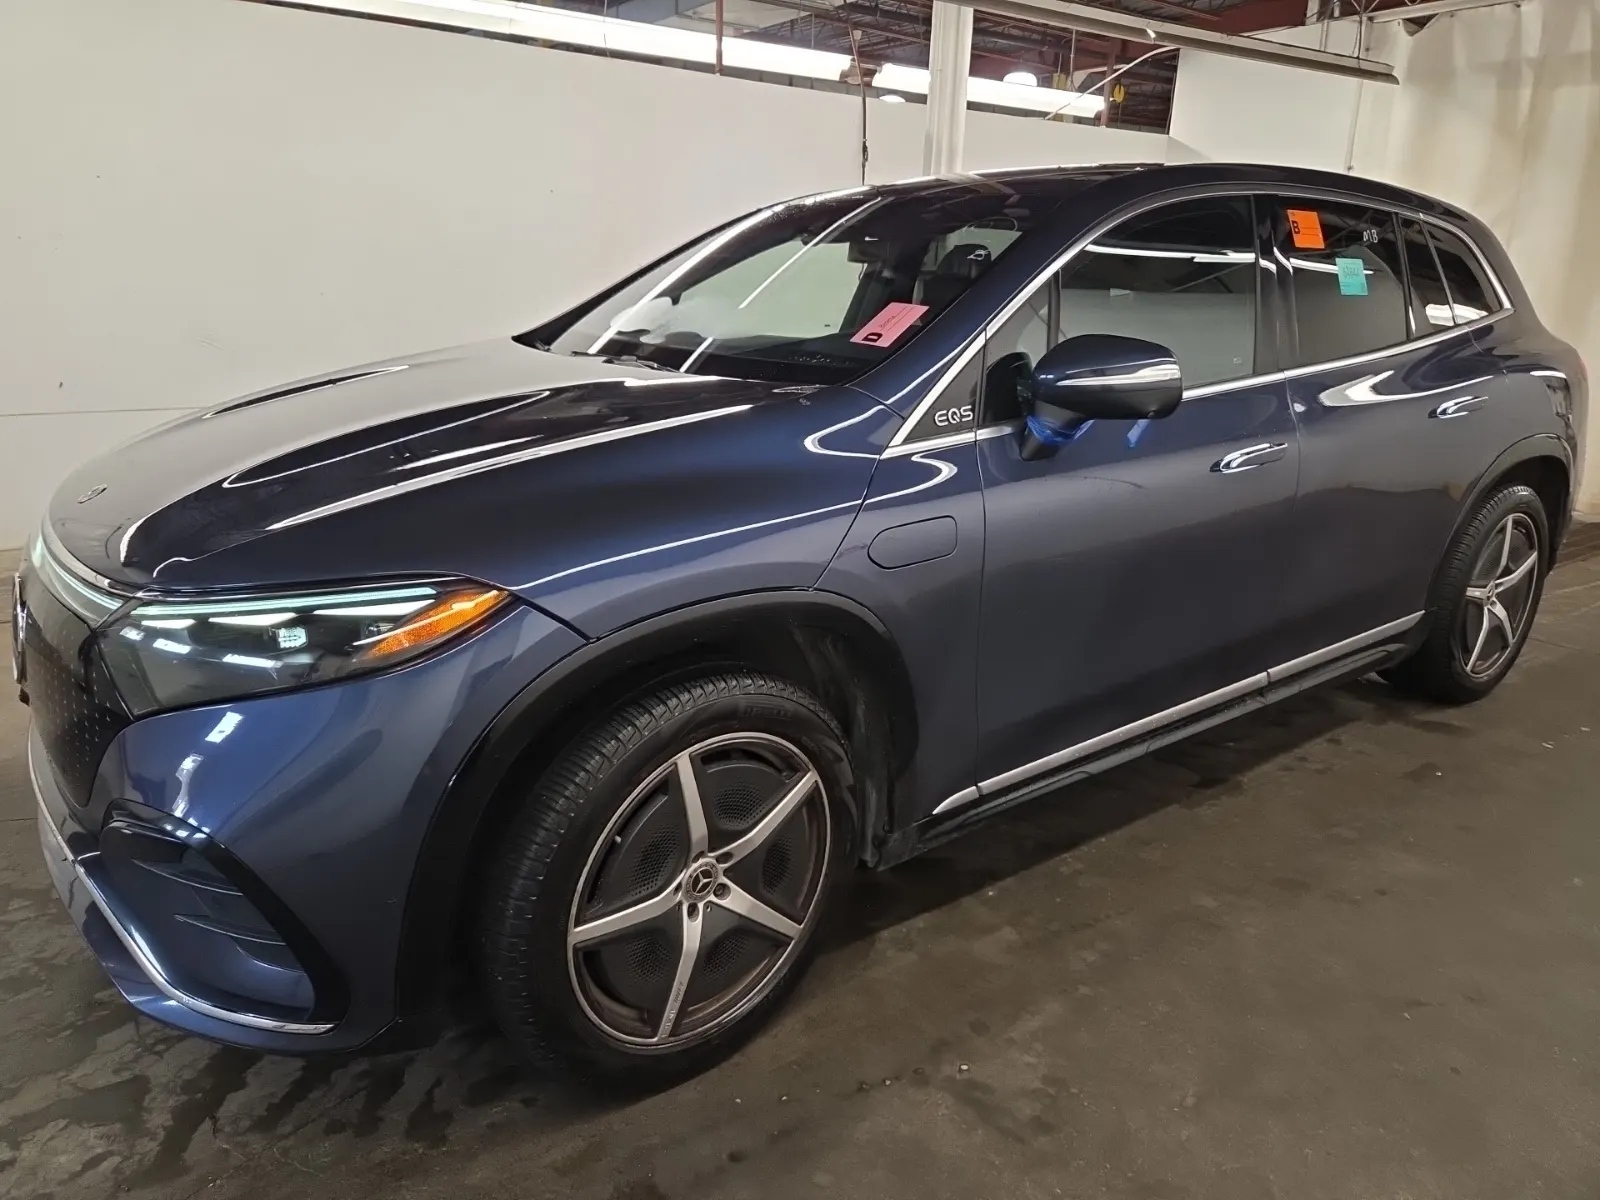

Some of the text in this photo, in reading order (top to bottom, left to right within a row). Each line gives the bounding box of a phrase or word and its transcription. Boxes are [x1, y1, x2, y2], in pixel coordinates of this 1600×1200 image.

[1291, 220, 1300, 234] B
[861, 332, 883, 343] D
[934, 405, 973, 426] EQS
